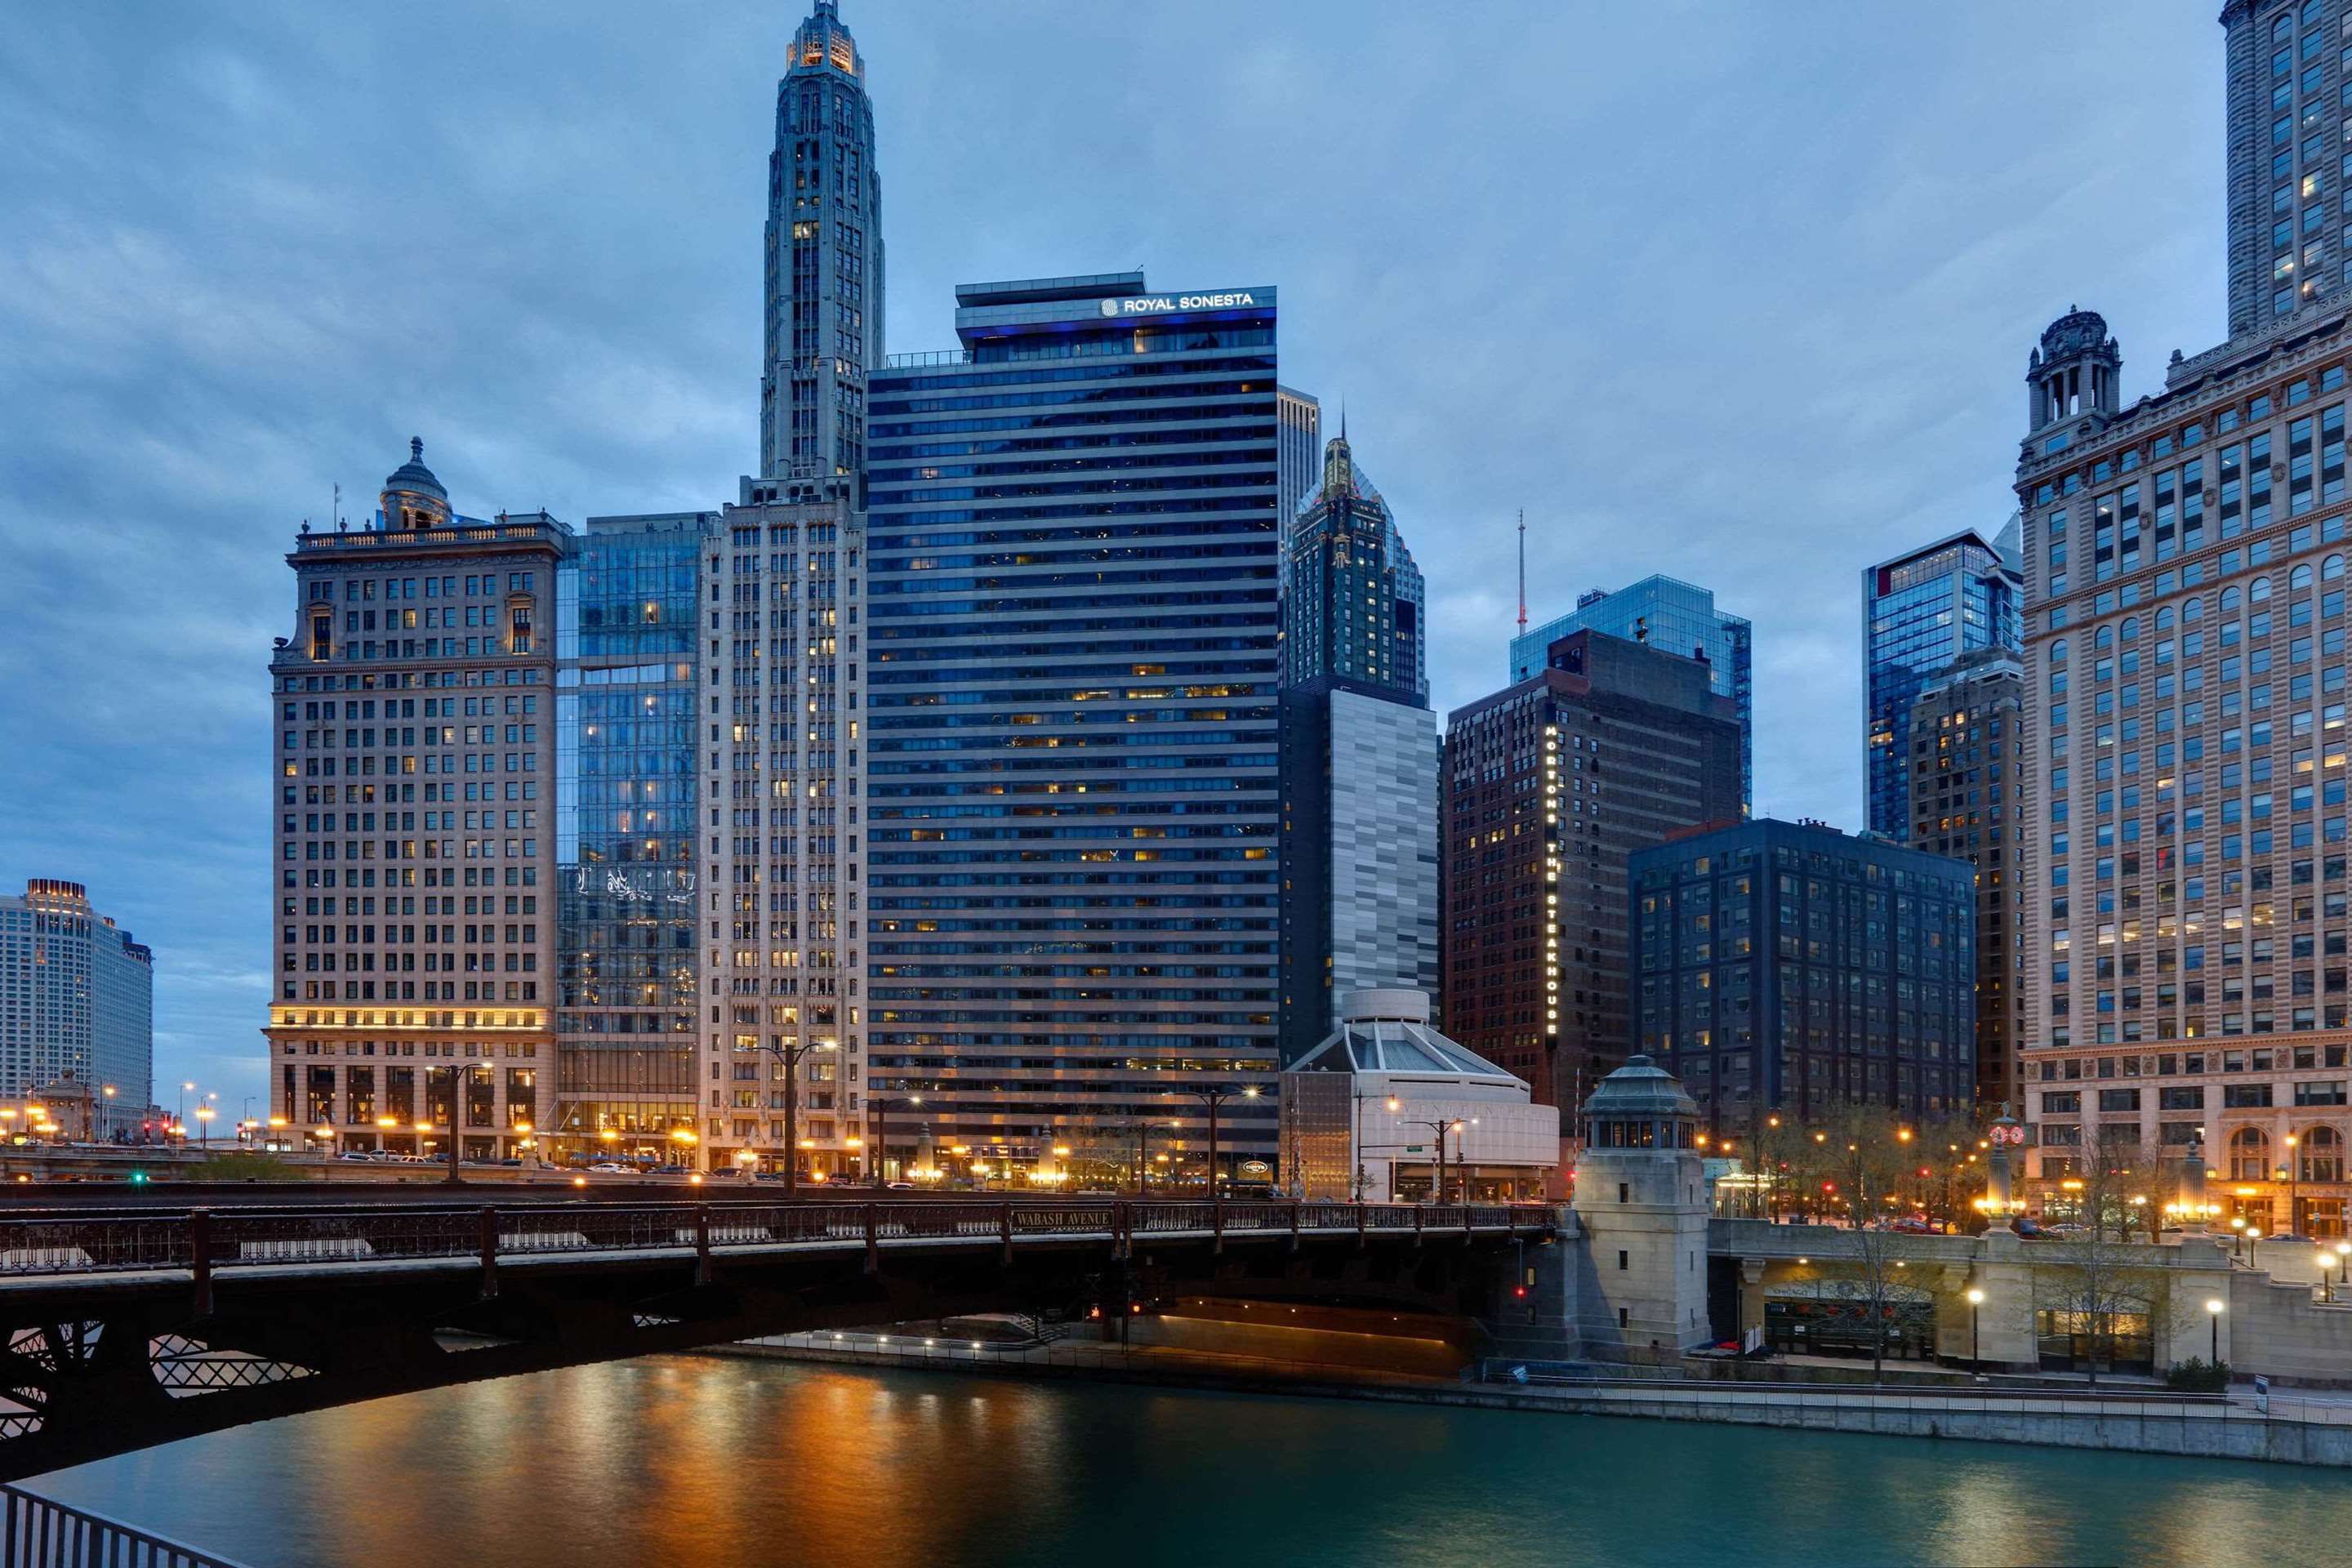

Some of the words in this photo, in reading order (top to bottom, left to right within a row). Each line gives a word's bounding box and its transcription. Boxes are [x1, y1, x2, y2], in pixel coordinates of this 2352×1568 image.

[1124, 299, 1176, 312] ROYAL
[1179, 293, 1254, 309] SONESTA
[1545, 727, 1557, 823] MORTONS
[1547, 843, 1557, 881] THE
[1547, 895, 1557, 1034] STEAKHOUSE
[1374, 1103, 1516, 1116] SVENTEENTH
[1017, 1213, 1062, 1226] WABASH
[1067, 1212, 1109, 1225] AVENUE
